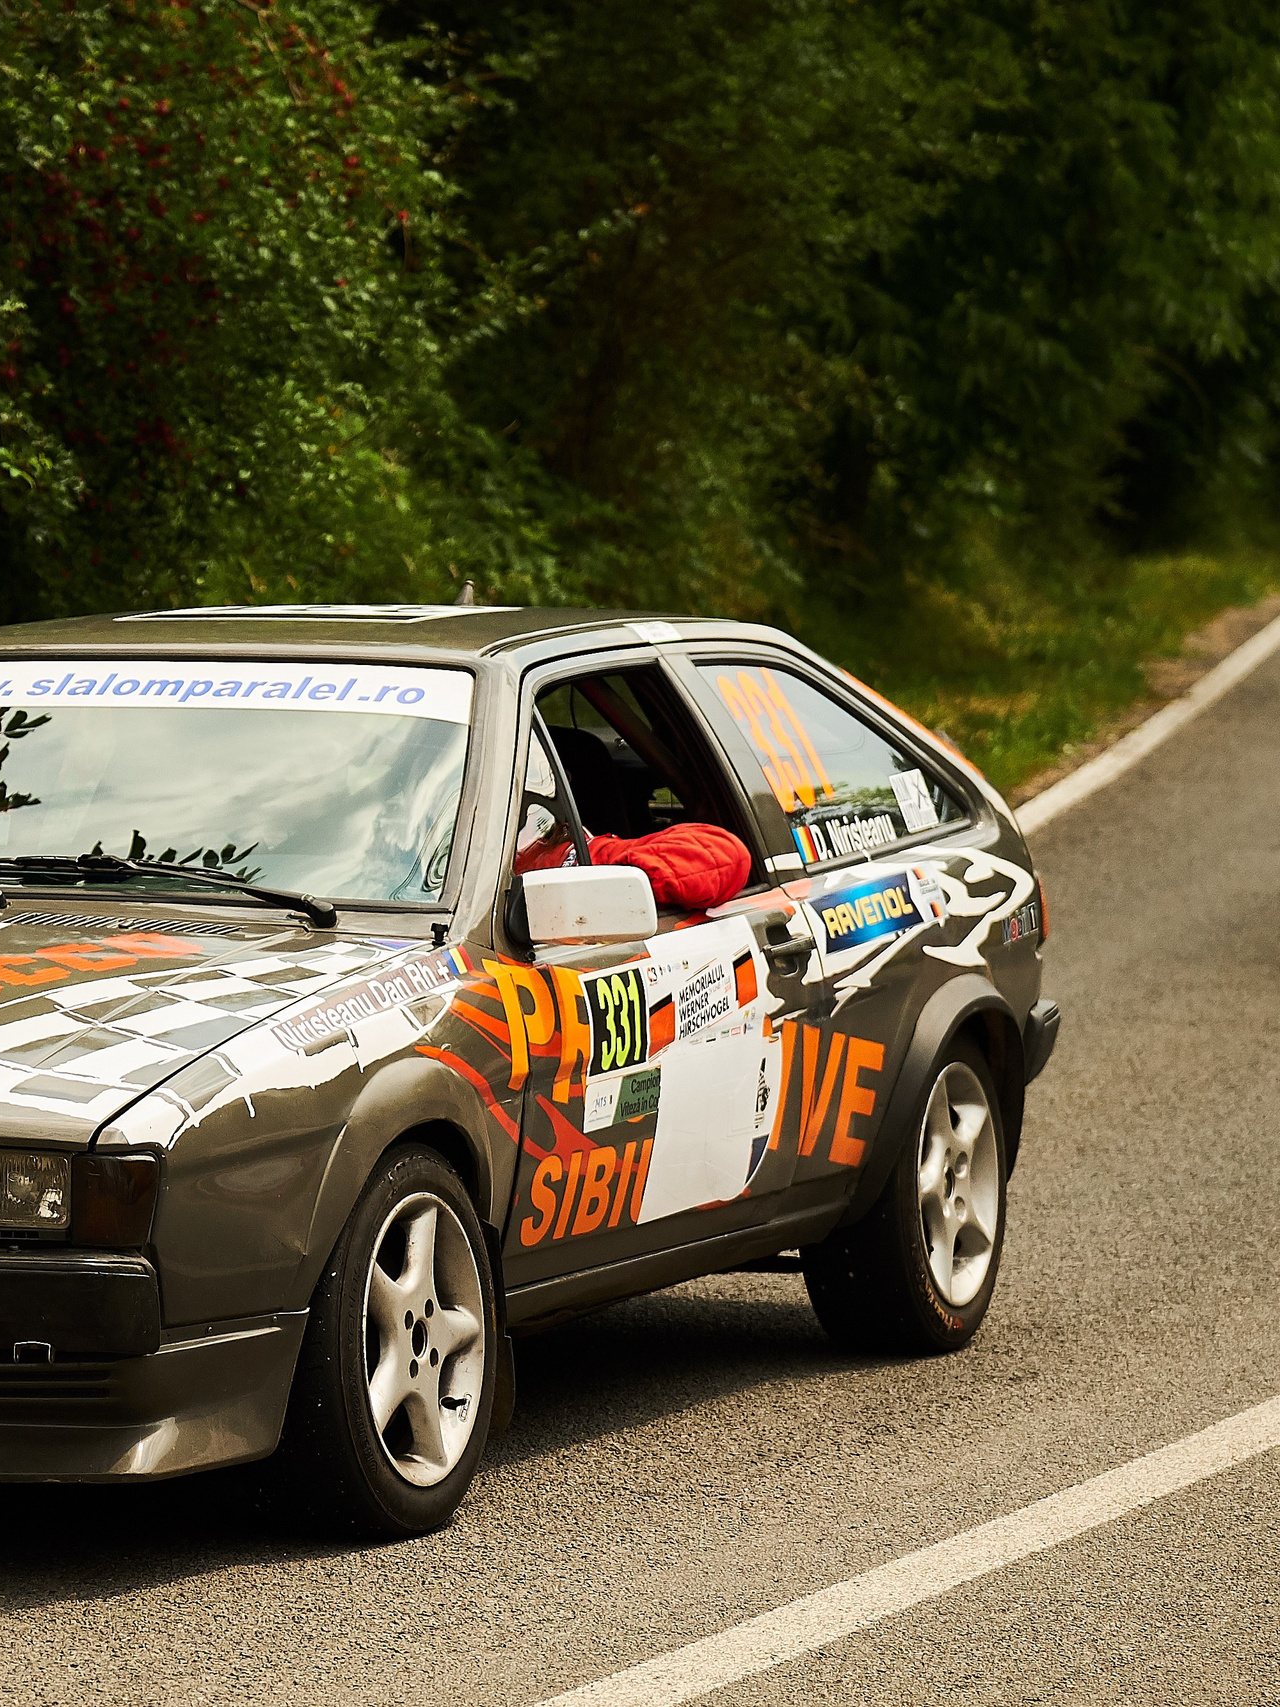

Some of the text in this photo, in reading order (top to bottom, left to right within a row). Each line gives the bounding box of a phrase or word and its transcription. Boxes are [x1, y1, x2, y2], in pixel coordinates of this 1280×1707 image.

[717, 667, 835, 813] 331
[809, 824, 833, 860] D.
[822, 886, 914, 939] RAVENOL
[367, 976, 412, 1009] Dan
[679, 964, 725, 1006] MEMORIALUL
[597, 970, 641, 1070] 331
[679, 991, 710, 1023] WERNER
[679, 996, 730, 1040] HIRSCHVOGEL
